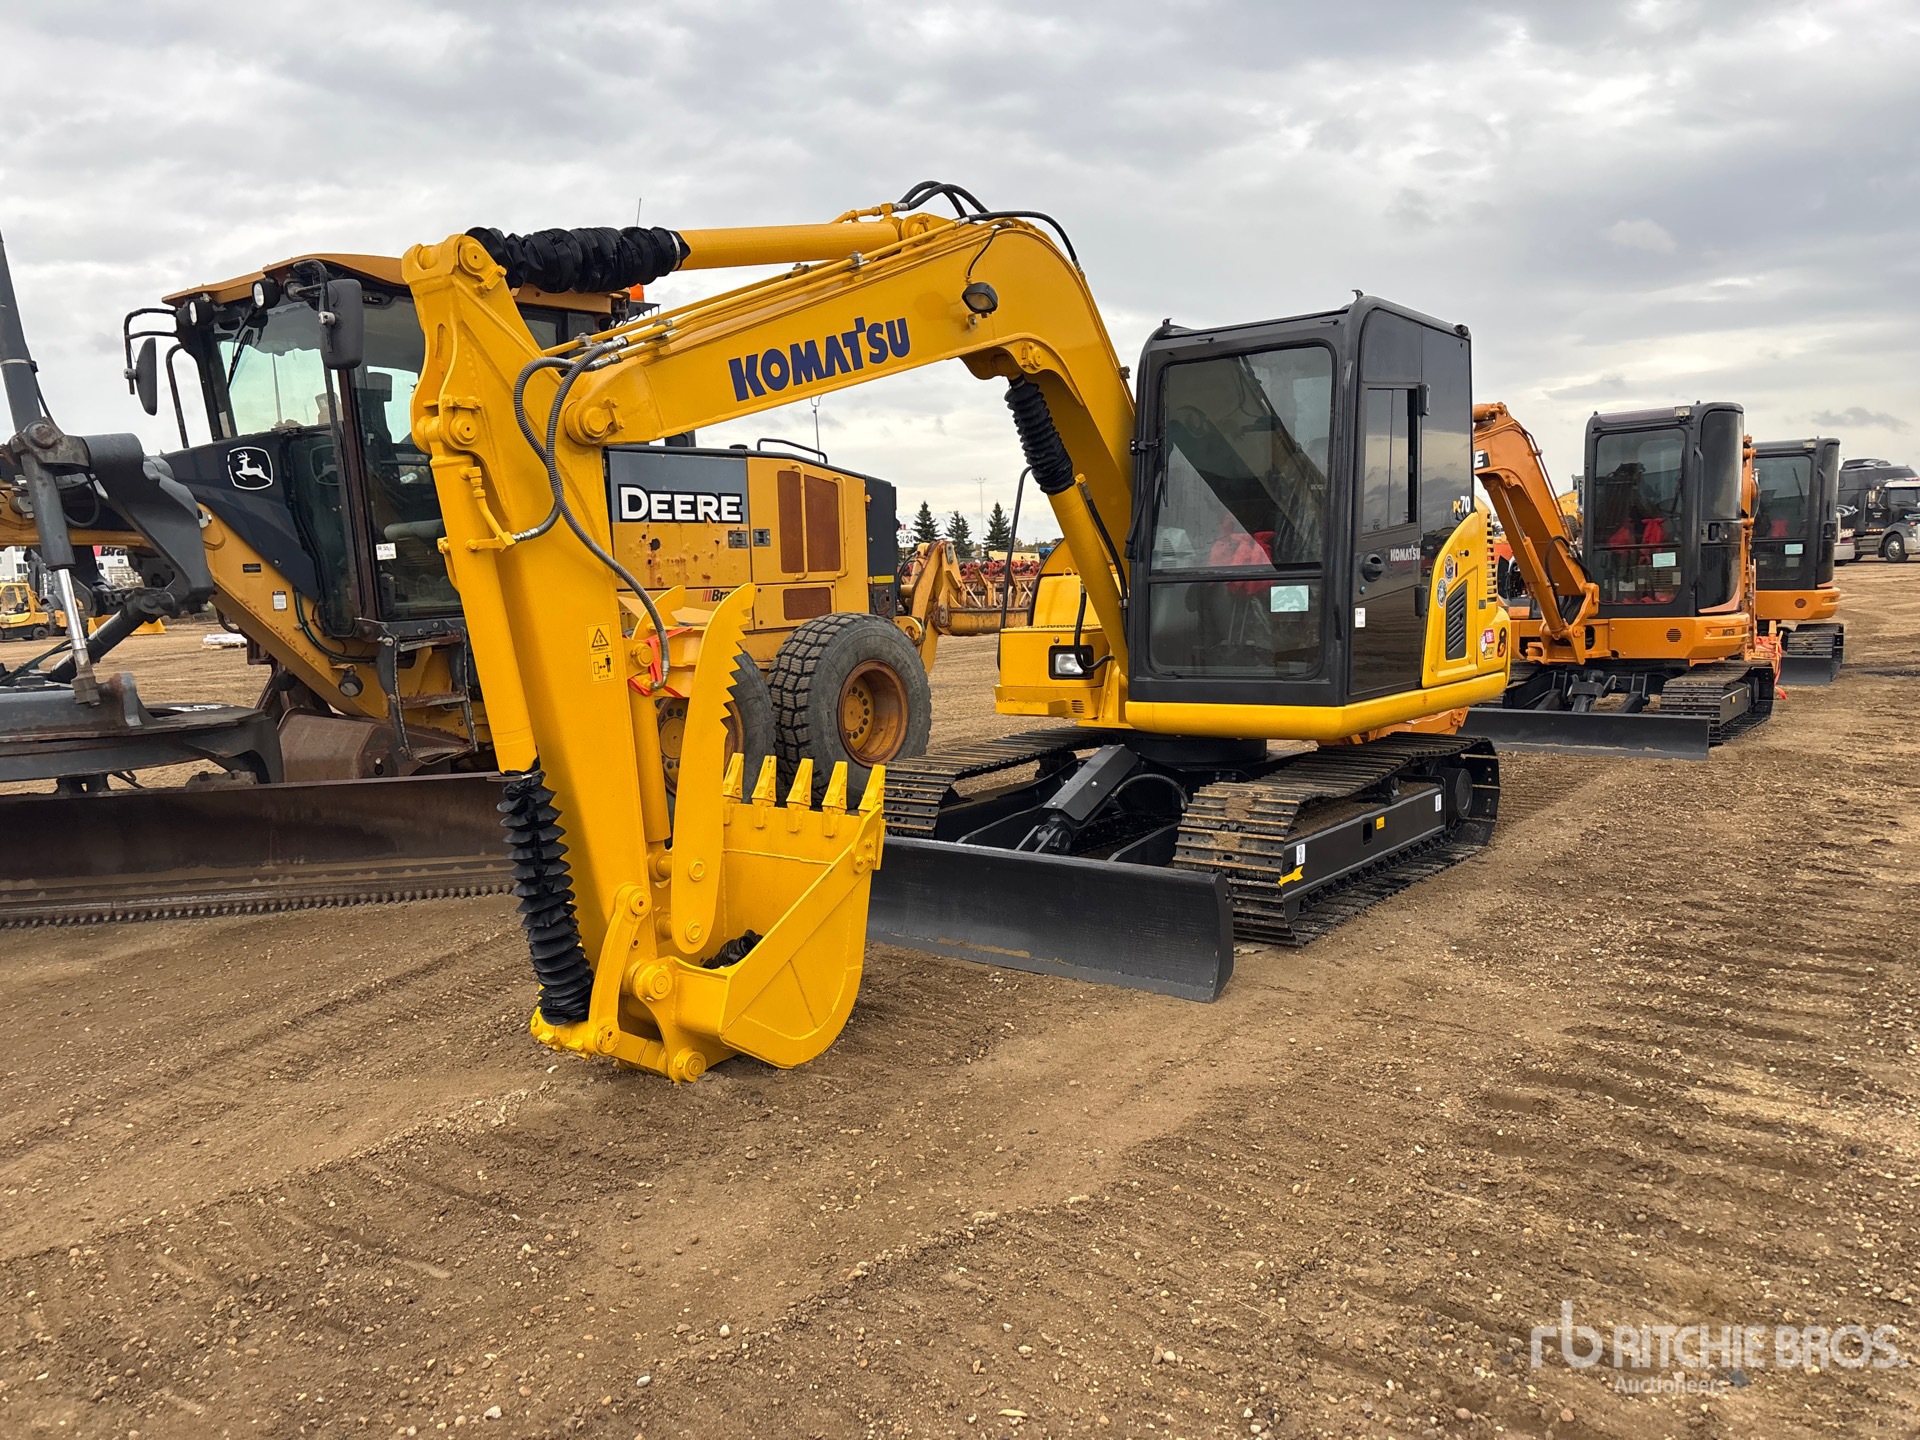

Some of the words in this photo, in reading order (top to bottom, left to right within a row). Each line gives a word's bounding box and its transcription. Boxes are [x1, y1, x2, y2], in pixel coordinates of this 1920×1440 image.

[728, 316, 911, 402] KOMATSU
[620, 486, 742, 521] DEERE
[1390, 545, 1420, 561] KOMATSU
